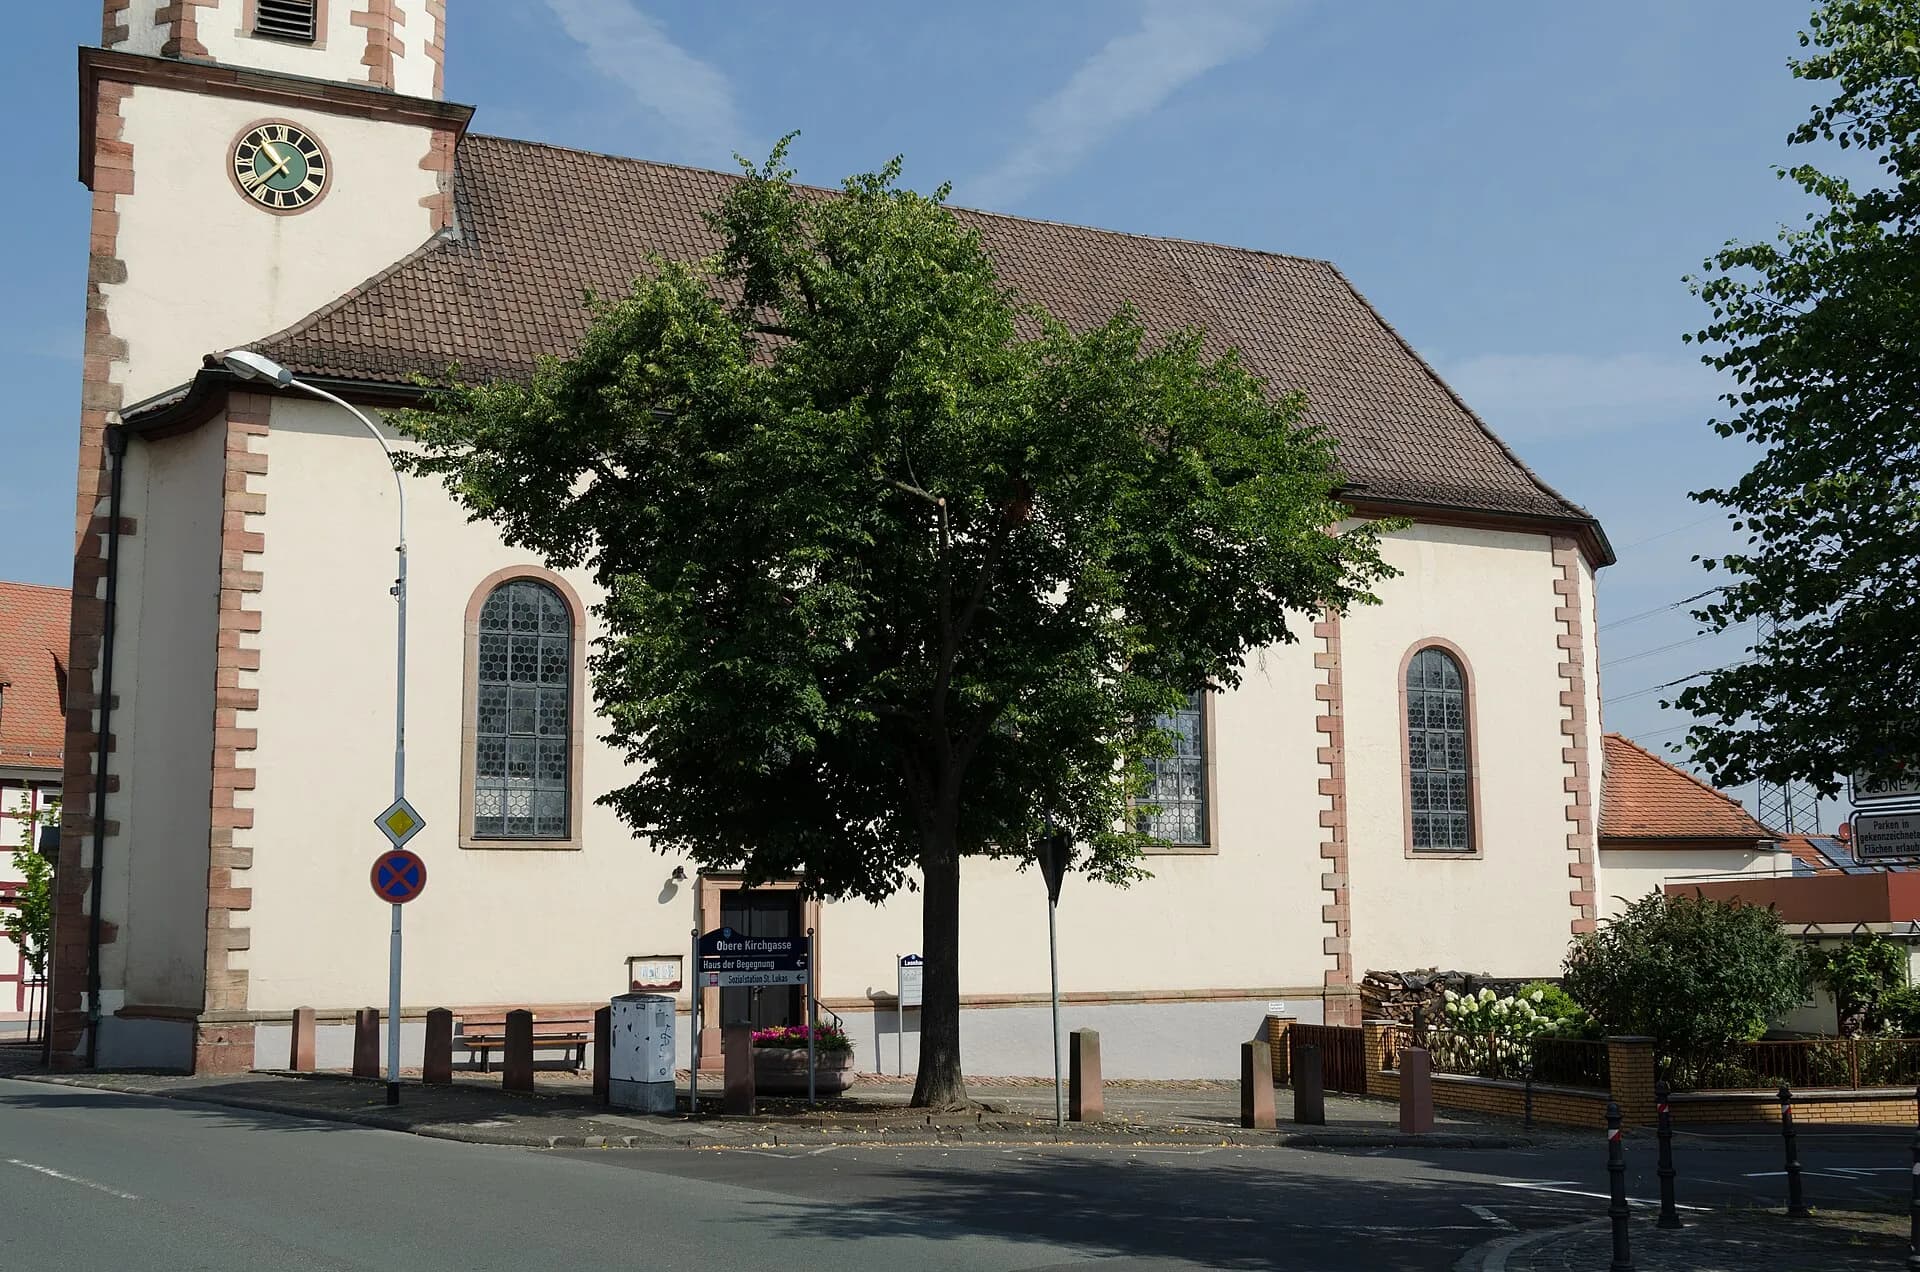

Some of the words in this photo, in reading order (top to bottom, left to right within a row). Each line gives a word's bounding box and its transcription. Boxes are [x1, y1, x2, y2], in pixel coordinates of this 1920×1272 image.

[1873, 820, 1899, 830] Parken
[1902, 819, 1909, 828] in
[716, 940, 742, 951] Obere
[744, 940, 792, 952] Kirchgasse
[703, 960, 721, 969] Haus
[722, 960, 735, 969] der
[736, 960, 775, 970] Begegnung
[728, 974, 762, 984] Sozialstation
[772, 974, 788, 983] Lukas
